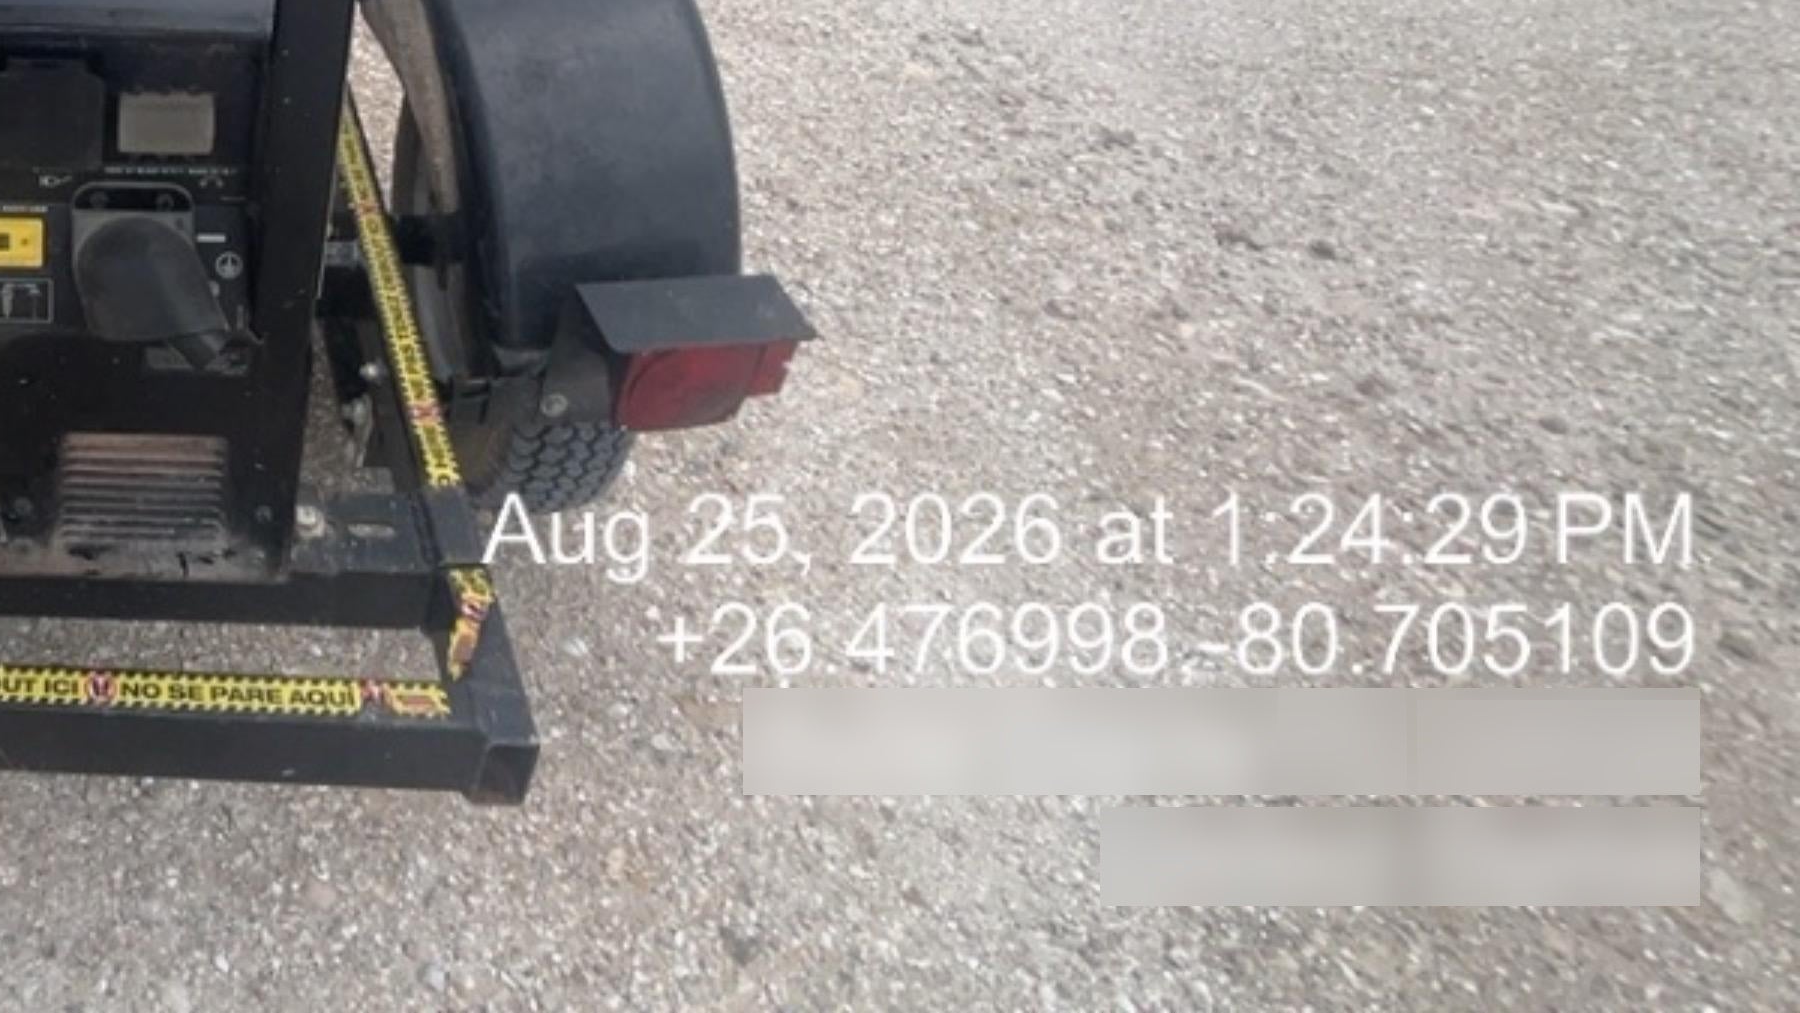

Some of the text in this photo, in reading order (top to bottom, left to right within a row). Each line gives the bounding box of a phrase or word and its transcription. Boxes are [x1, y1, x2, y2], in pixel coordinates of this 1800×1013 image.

[45, 680, 80, 696] ICI
[121, 682, 161, 700] NO
[168, 685, 201, 701] SE
[211, 686, 282, 704] PARE
